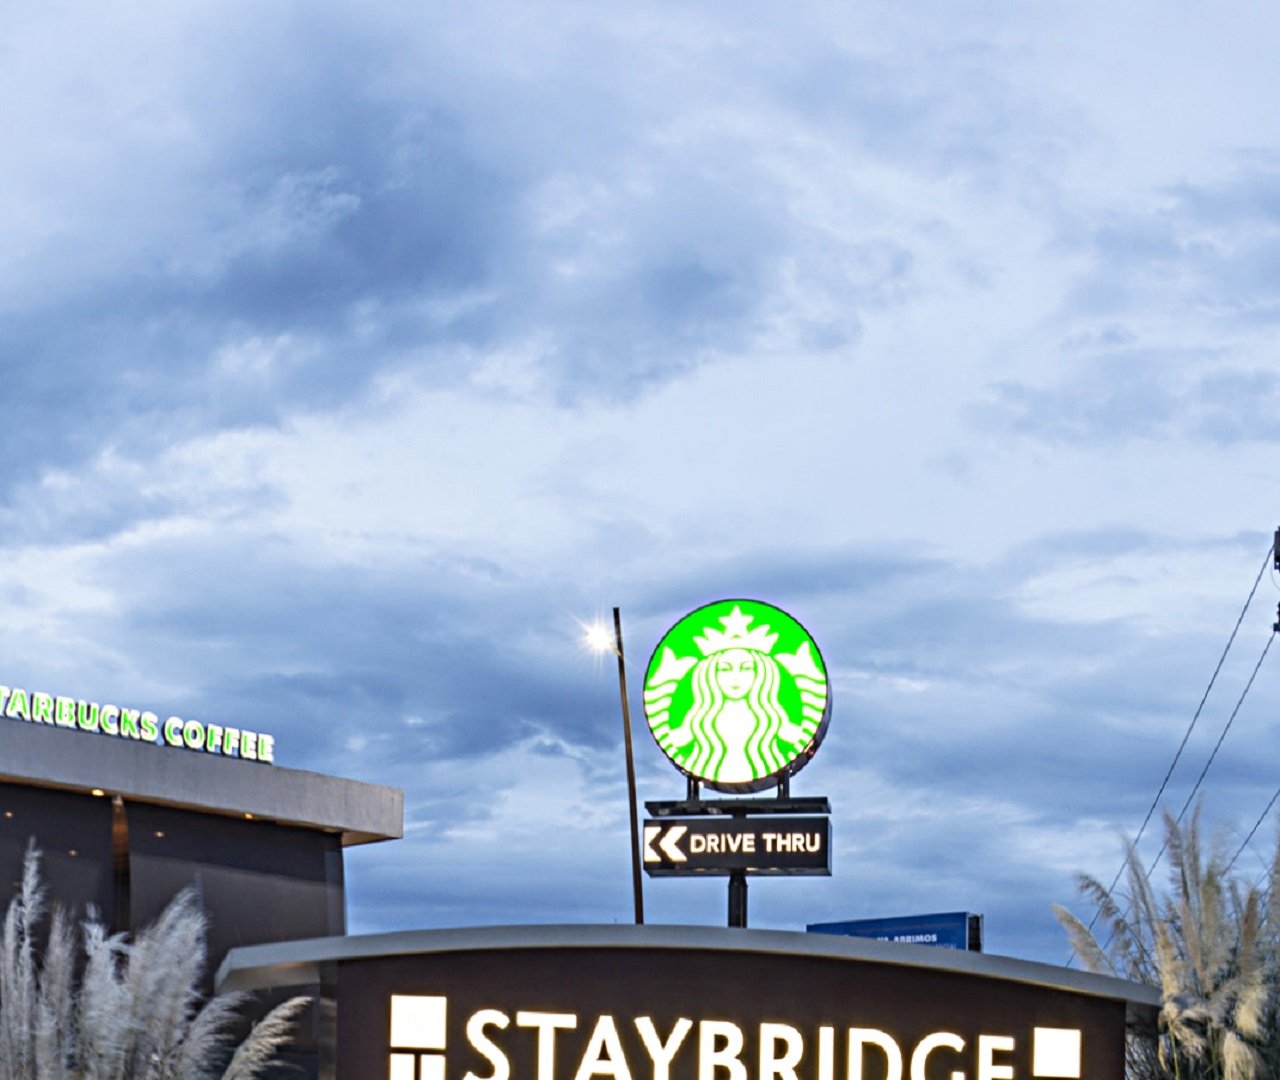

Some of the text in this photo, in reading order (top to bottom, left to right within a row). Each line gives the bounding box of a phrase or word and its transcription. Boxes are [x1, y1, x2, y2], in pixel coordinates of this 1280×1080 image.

[163, 716, 275, 764] COFFEE
[690, 833, 820, 853] DRIVE THRU
